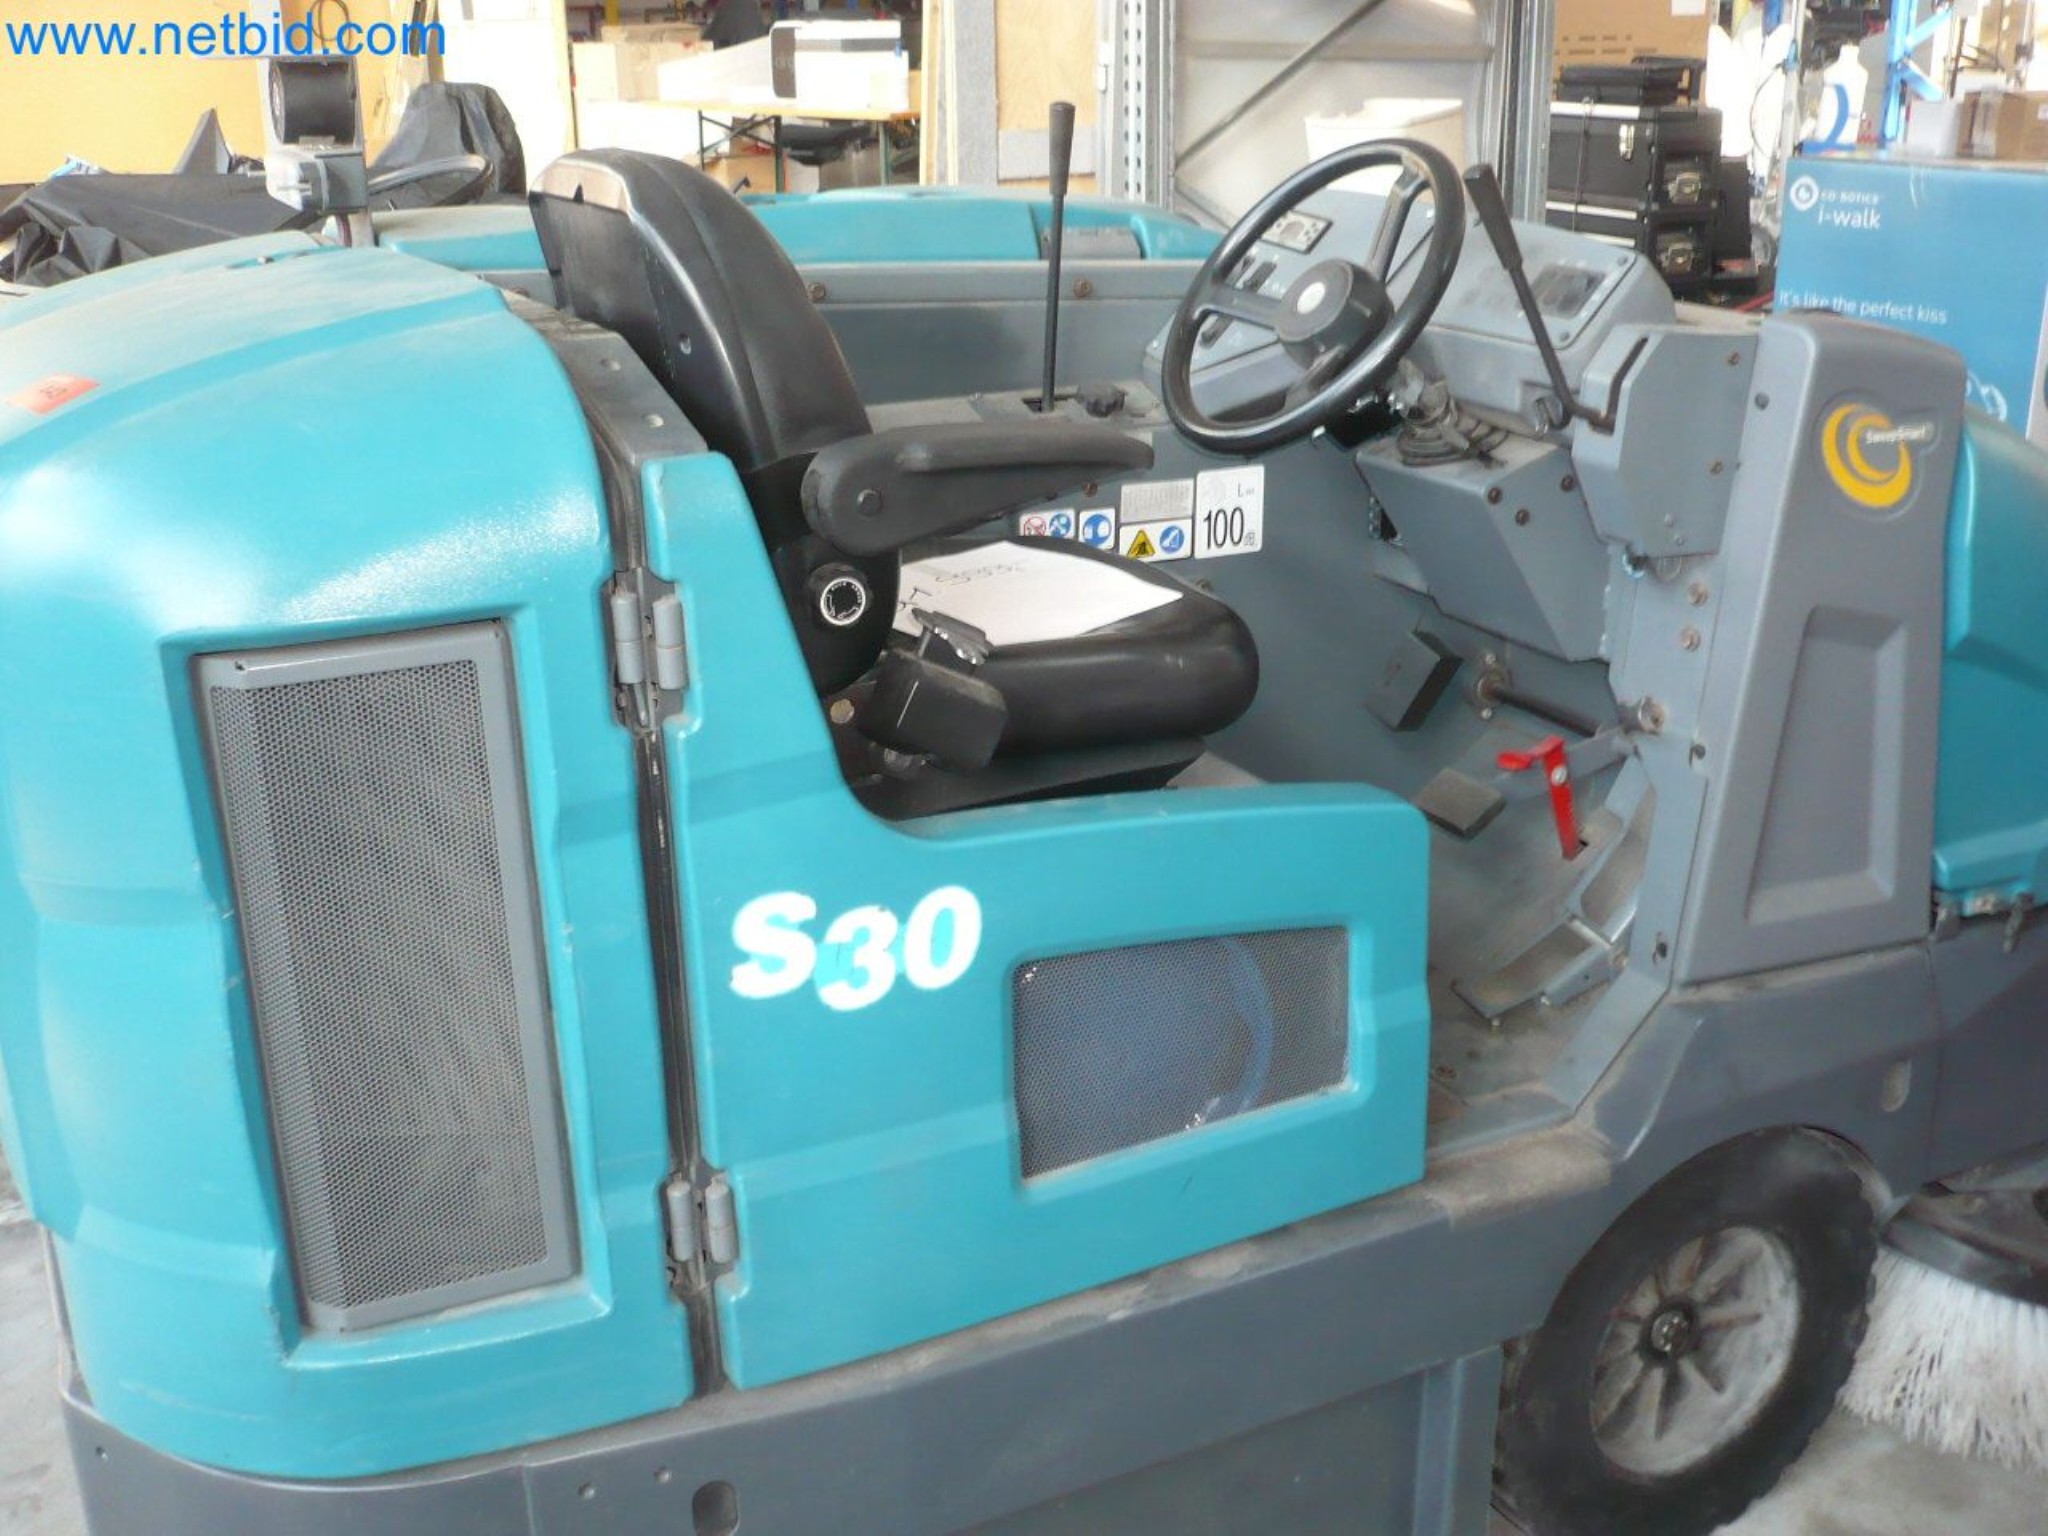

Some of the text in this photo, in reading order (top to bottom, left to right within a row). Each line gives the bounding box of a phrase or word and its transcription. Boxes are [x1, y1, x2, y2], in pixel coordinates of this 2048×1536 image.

[1818, 204, 1881, 229] i-walk
[1803, 292, 1830, 310] like
[1833, 295, 1857, 314] the
[1859, 299, 1913, 321] perfect
[1916, 304, 1948, 326] kiss
[1203, 506, 1245, 550] 100
[728, 884, 983, 1013] S30
